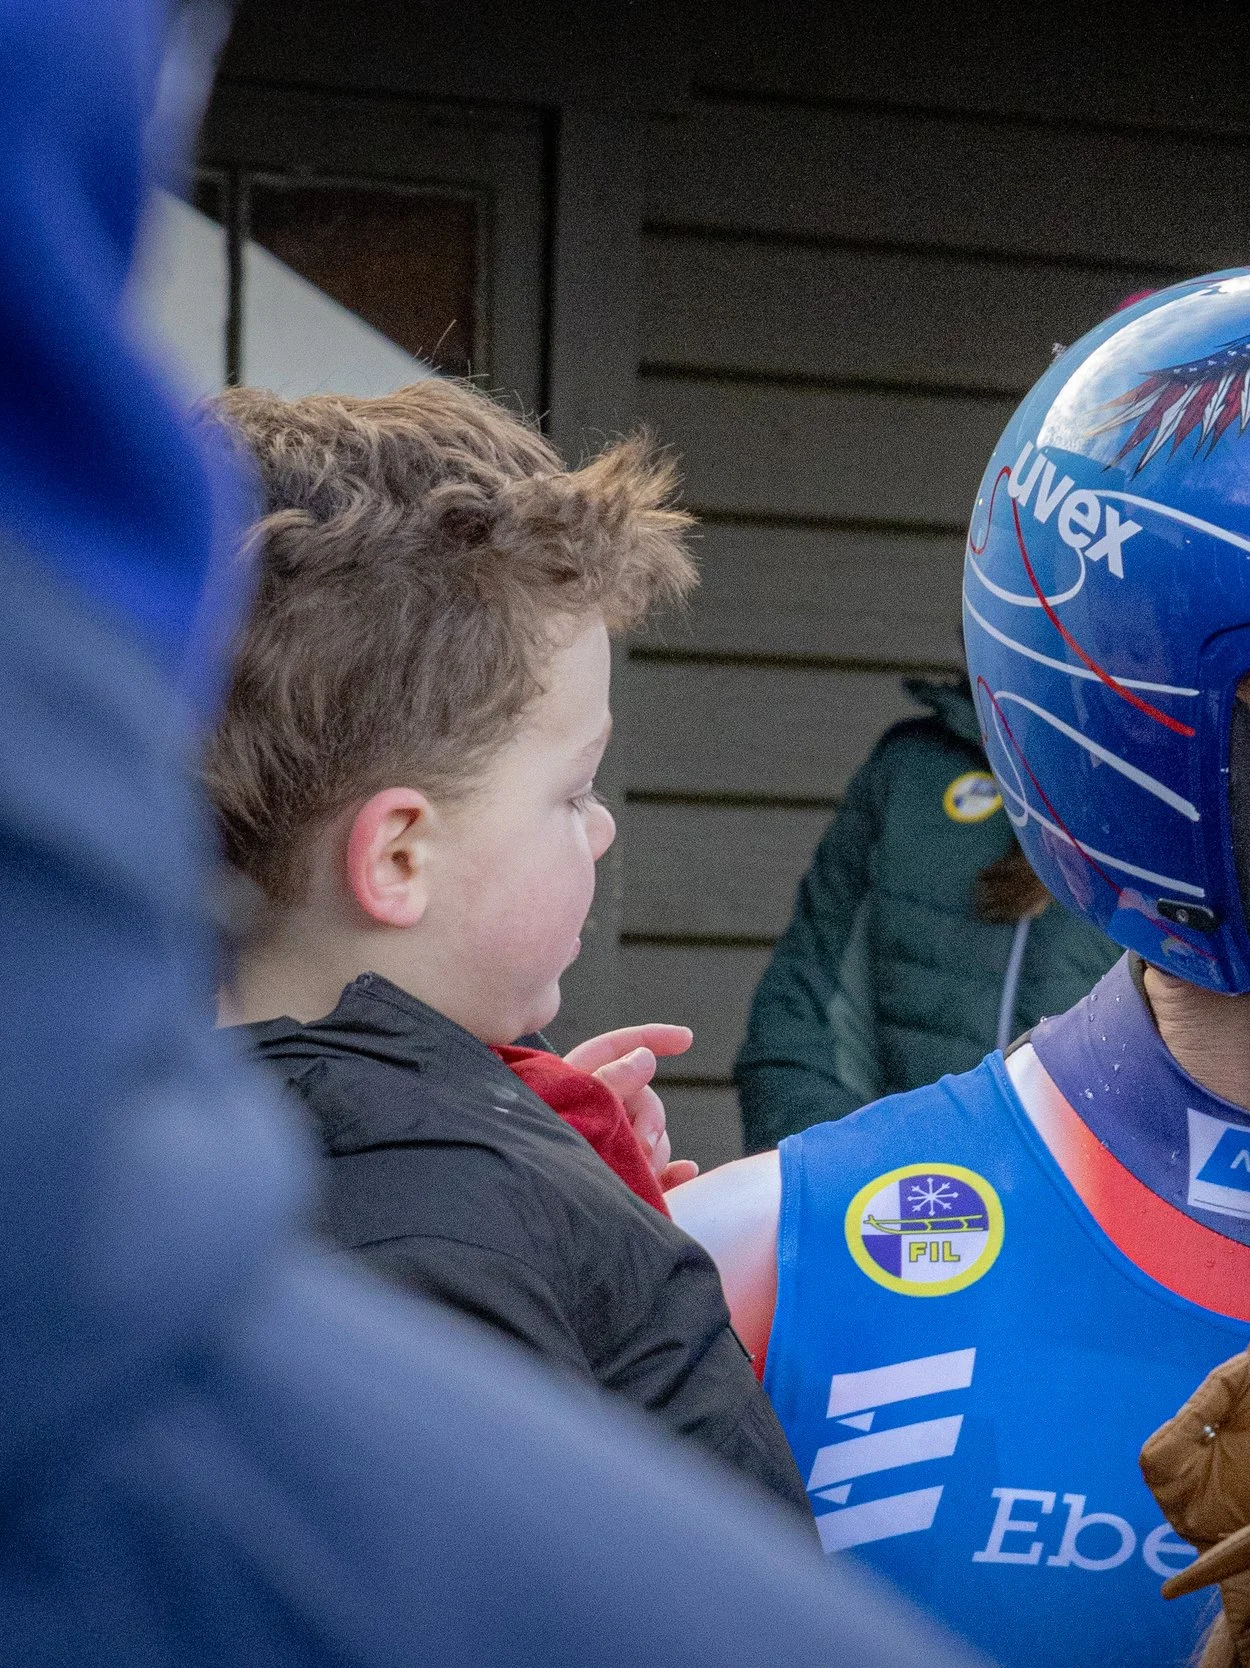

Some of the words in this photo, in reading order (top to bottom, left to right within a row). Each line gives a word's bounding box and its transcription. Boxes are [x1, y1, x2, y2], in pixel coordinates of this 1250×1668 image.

[1007, 440, 1143, 579] uvex
[909, 1240, 961, 1263] FIL
[972, 1487, 1199, 1579] Ebe
